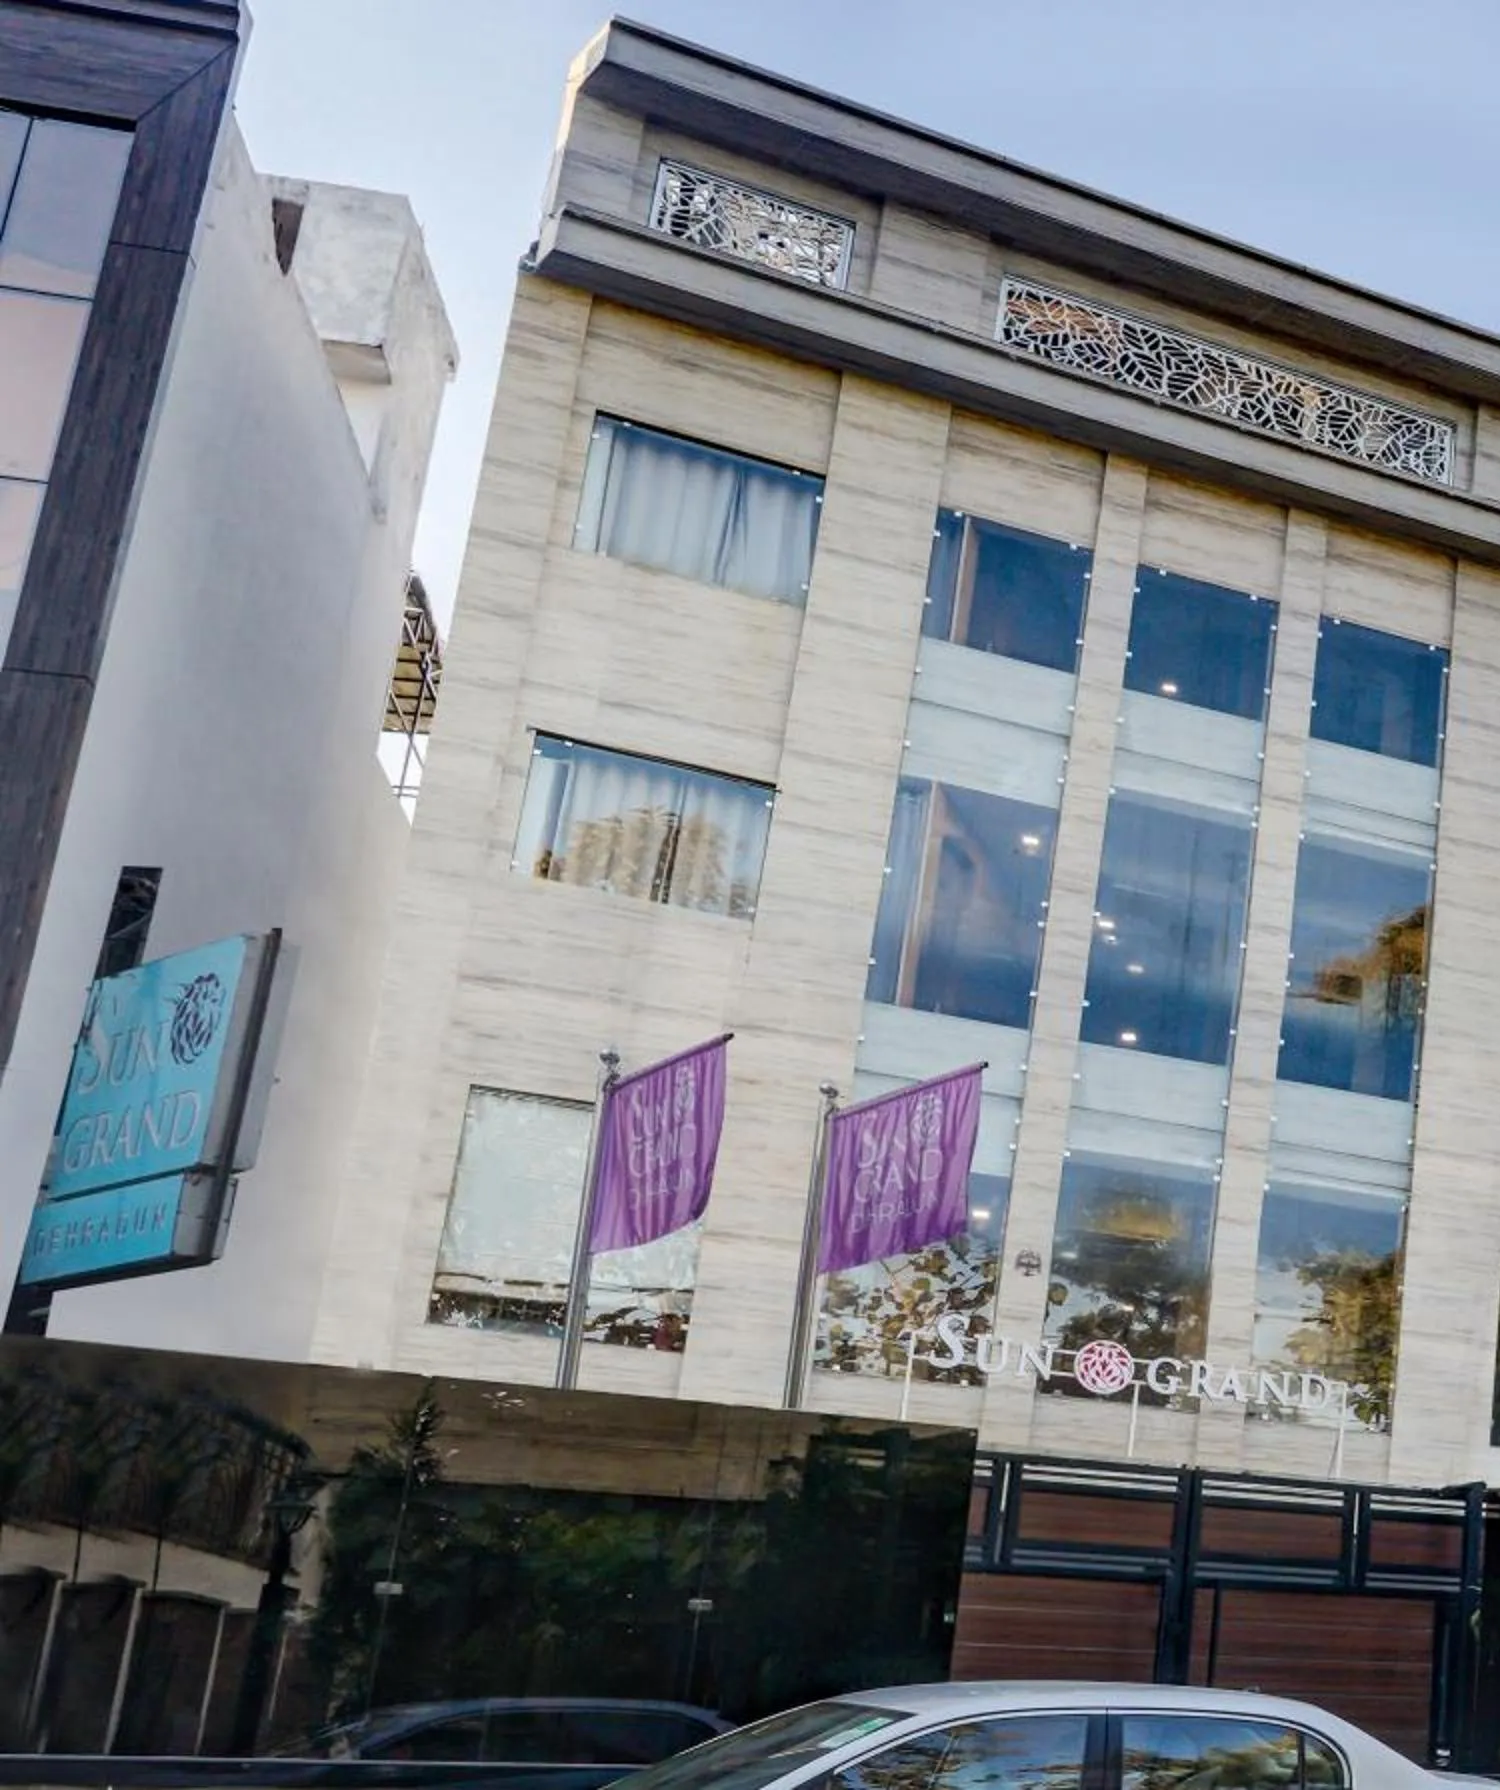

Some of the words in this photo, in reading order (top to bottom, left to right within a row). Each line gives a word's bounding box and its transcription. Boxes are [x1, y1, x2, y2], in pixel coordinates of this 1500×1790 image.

[66, 1092, 199, 1170] GRAND
[36, 1203, 167, 1255] DEHRADUN
[928, 1313, 1057, 1380] SUN
[1147, 1357, 1329, 1409] GRAND
